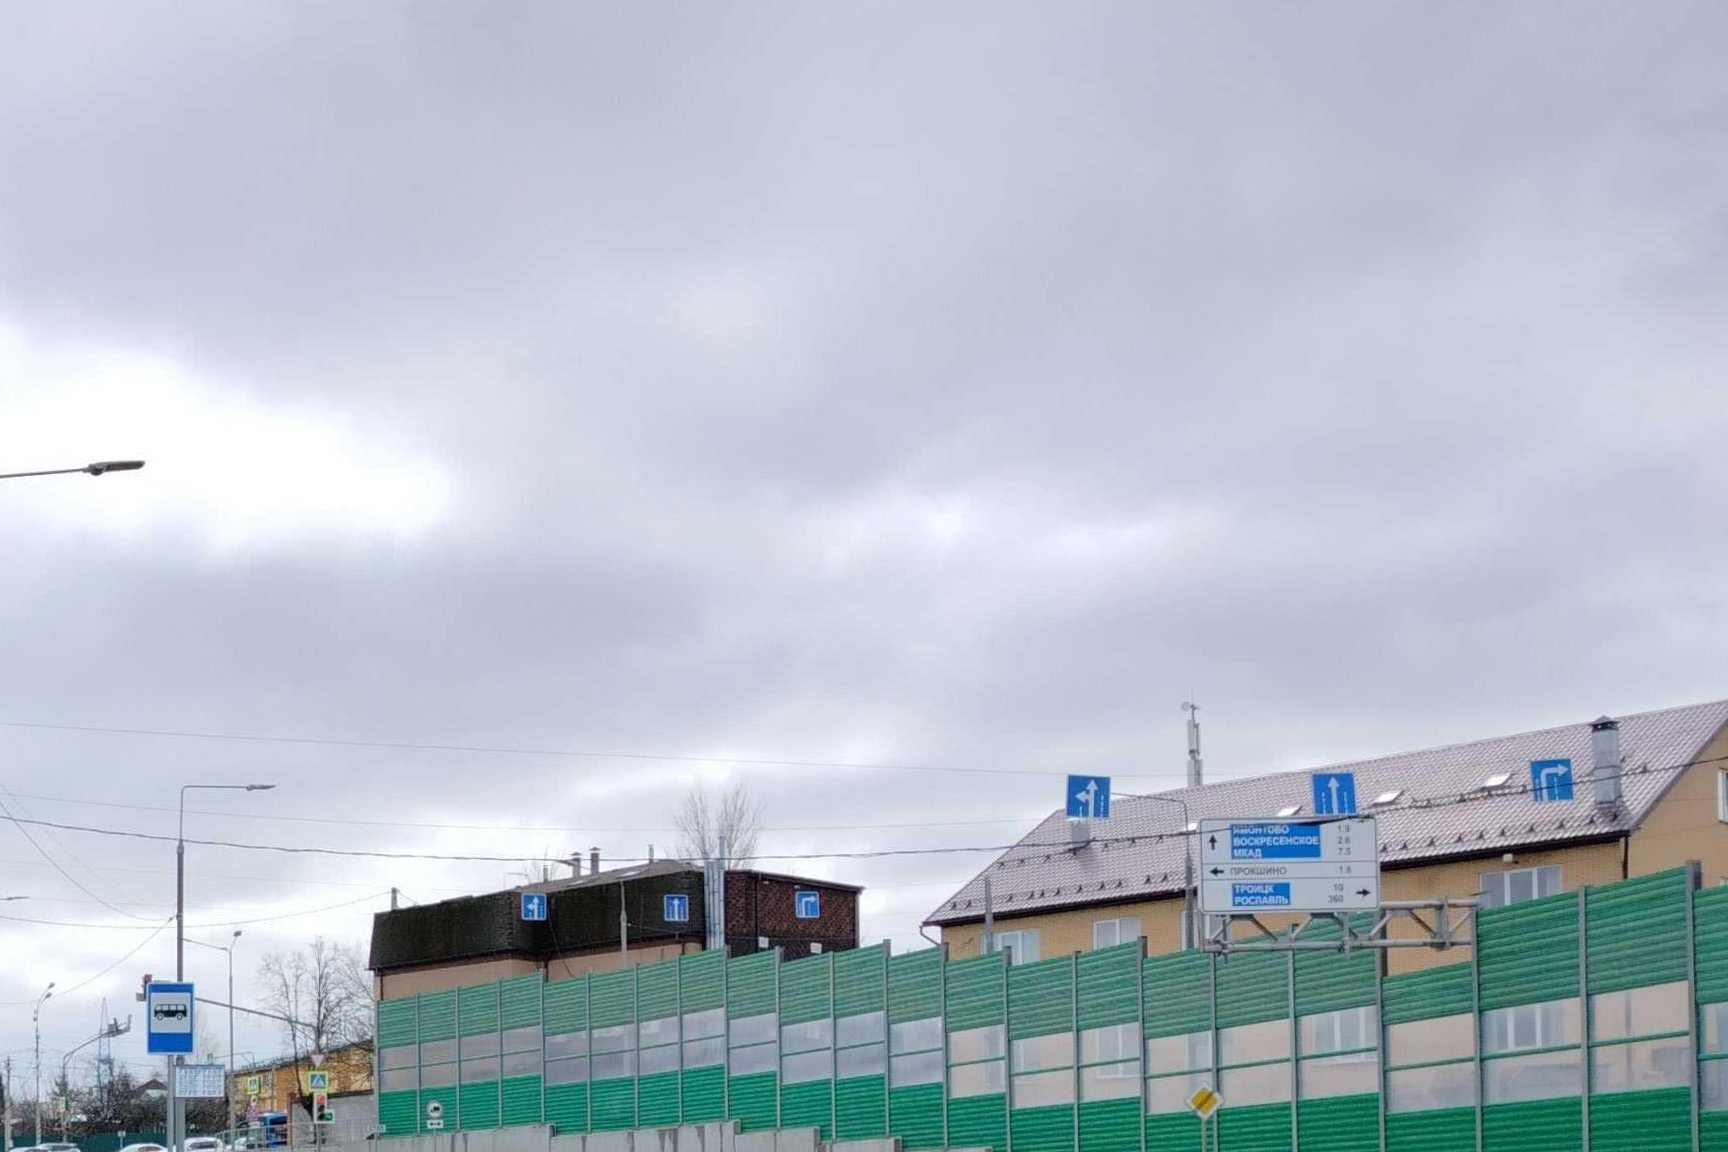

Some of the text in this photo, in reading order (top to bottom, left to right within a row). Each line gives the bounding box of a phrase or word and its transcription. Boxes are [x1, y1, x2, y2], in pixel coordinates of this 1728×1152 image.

[1233, 836, 1319, 847] ВОСКРЕСЕНСКОЕ
[1233, 848, 1263, 859] МКАД
[1230, 866, 1287, 876] ПРОКШИНО
[1234, 884, 1274, 895] ТРОИЦК
[1234, 896, 1290, 905] РОСЛАВЛЬ
